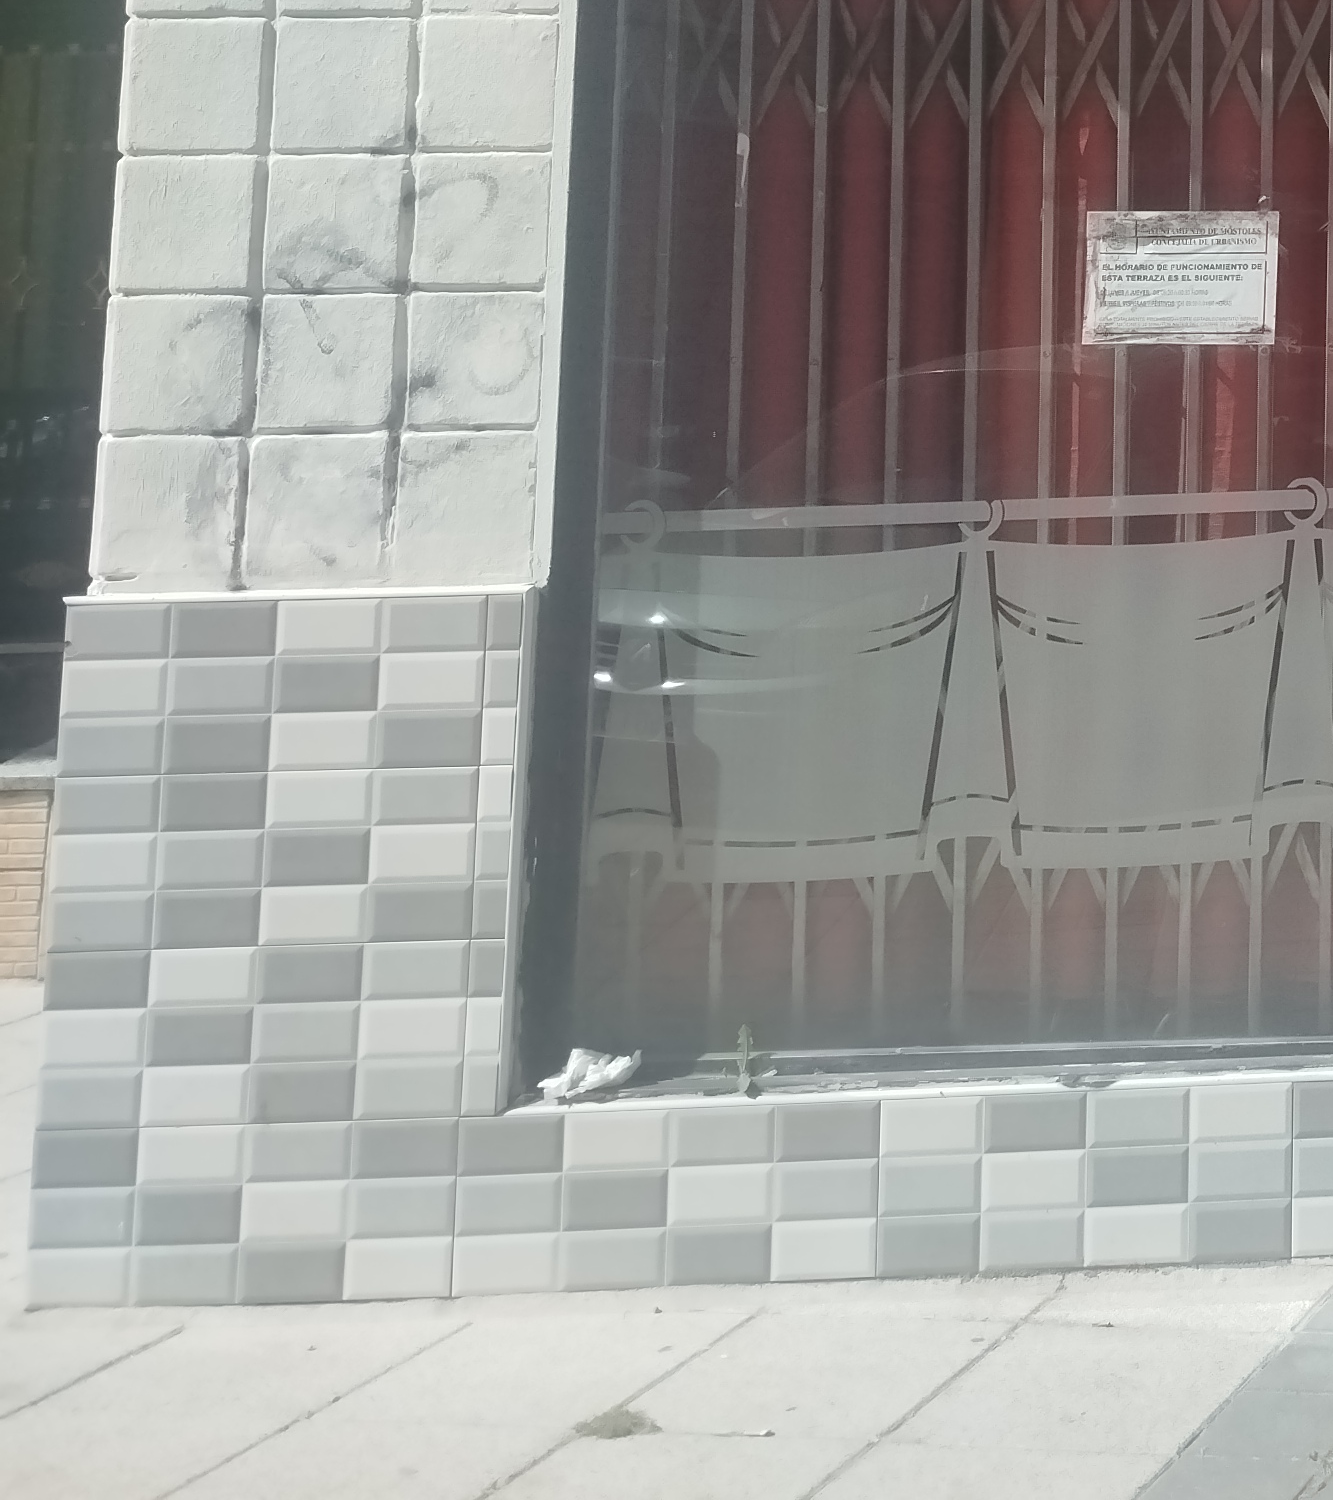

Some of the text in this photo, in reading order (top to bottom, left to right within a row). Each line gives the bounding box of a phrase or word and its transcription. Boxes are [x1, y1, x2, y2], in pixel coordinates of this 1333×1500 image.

[1102, 263, 1114, 271] EL
[1157, 263, 1168, 271] DE
[1170, 263, 1249, 271] FUNCIONAMIENTO
[1251, 263, 1263, 271] DE
[1101, 274, 1124, 282] ESTA
[1125, 274, 1166, 282] TERRAZA
[1168, 274, 1179, 282] ES
[1181, 274, 1192, 282] EL
